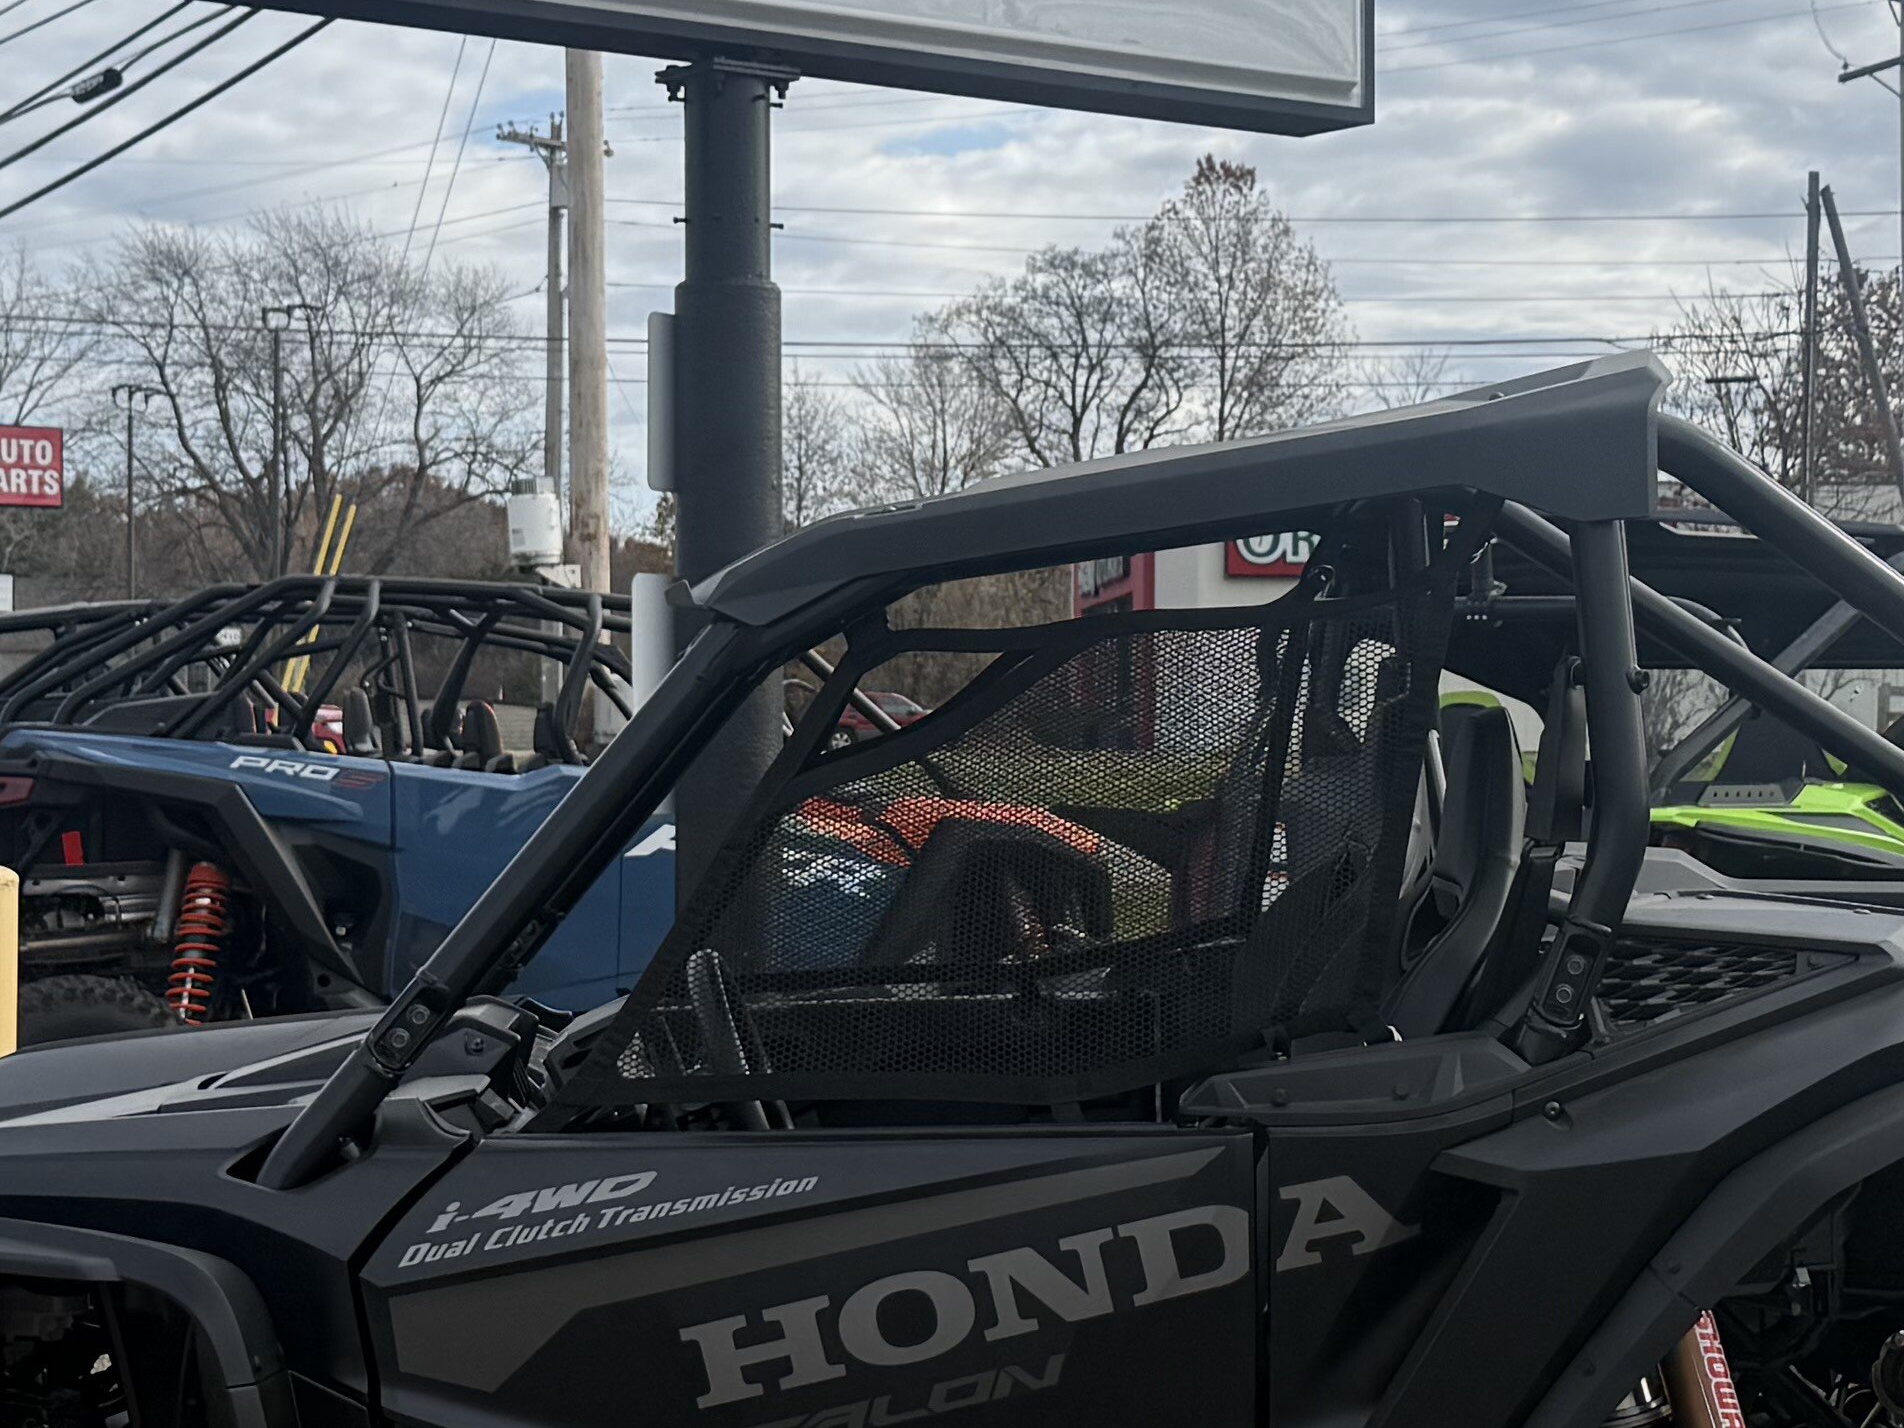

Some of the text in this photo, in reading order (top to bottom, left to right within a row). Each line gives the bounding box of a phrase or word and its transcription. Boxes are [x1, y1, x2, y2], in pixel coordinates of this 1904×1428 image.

[229, 755, 340, 781] PRO
[398, 1176, 819, 1268] Dual Clutch Transmission
[426, 1171, 658, 1234] i-4WD
[679, 1173, 1421, 1410] HONDA
